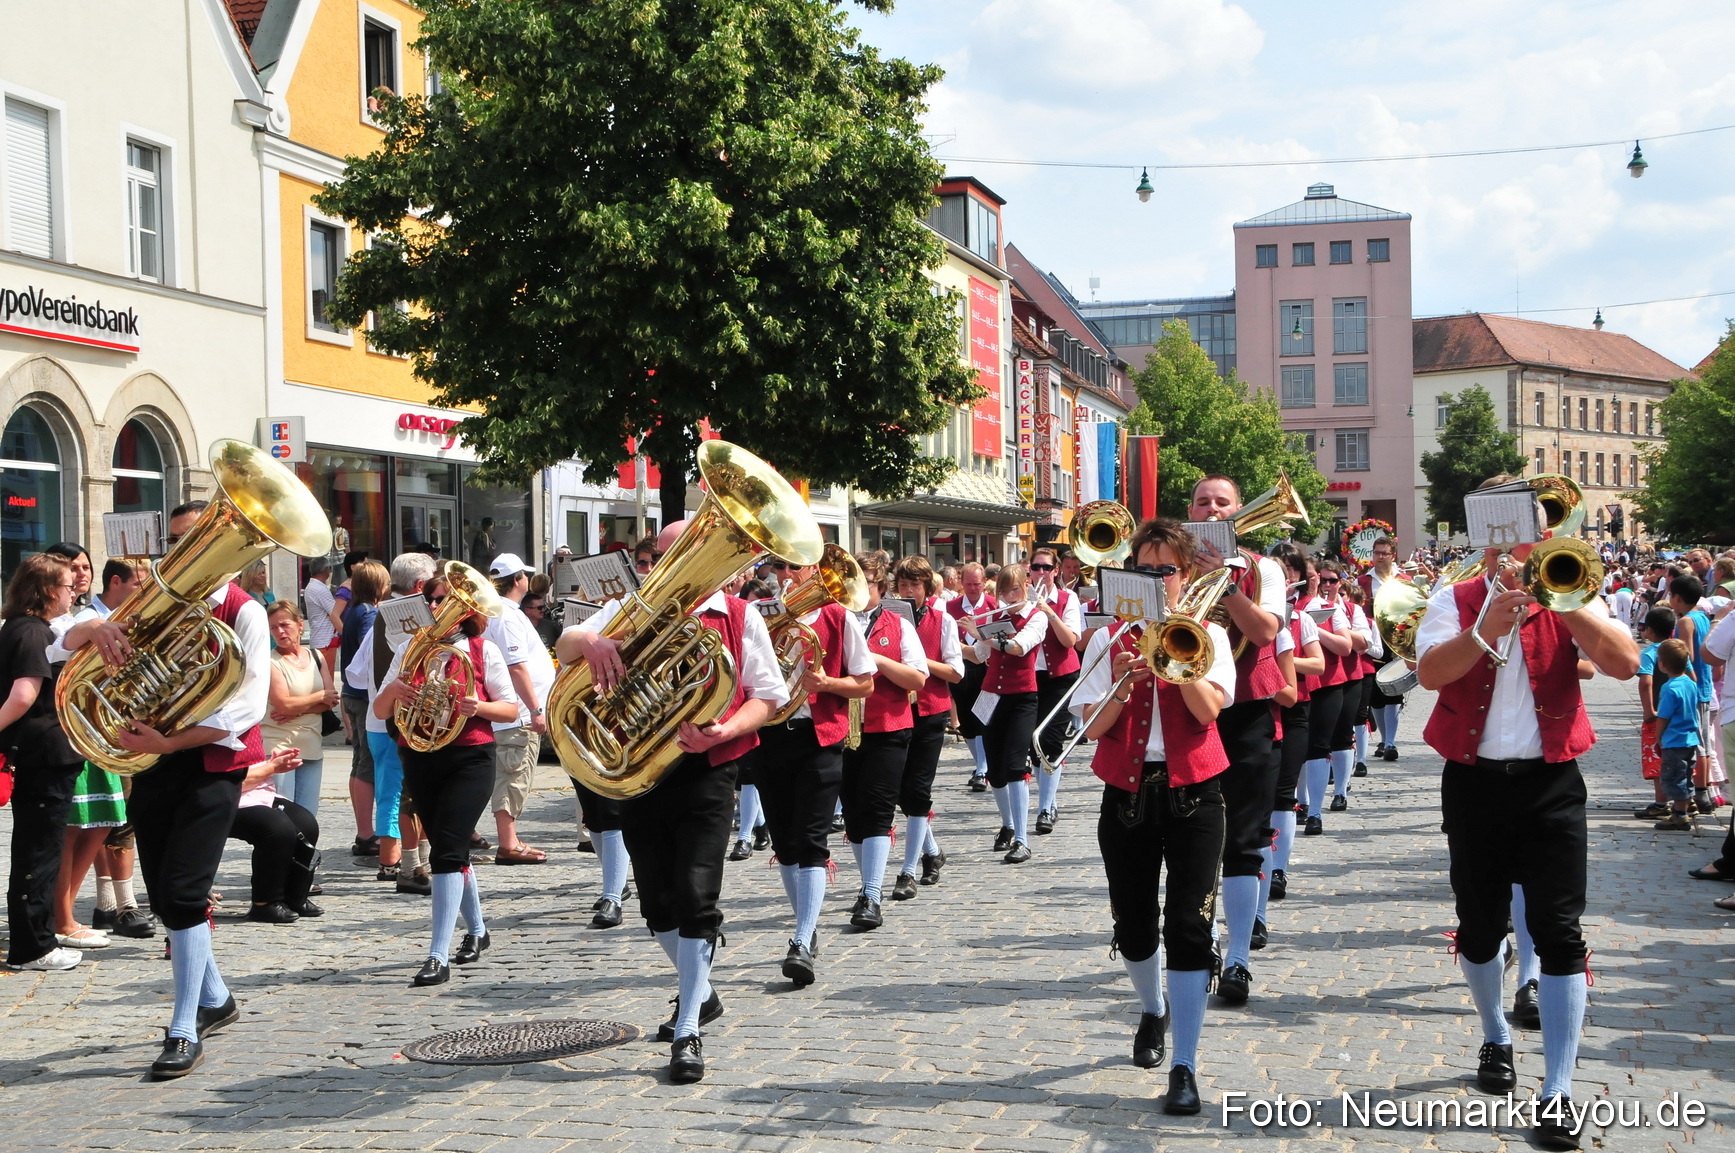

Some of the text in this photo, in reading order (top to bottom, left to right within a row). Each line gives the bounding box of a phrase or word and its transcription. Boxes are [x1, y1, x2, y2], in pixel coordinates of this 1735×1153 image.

[1020, 361, 1031, 473] BÄCKEREI
[1019, 477, 1034, 486] café
[1327, 482, 1361, 491] asse
[8, 496, 36, 507] Aktuell
